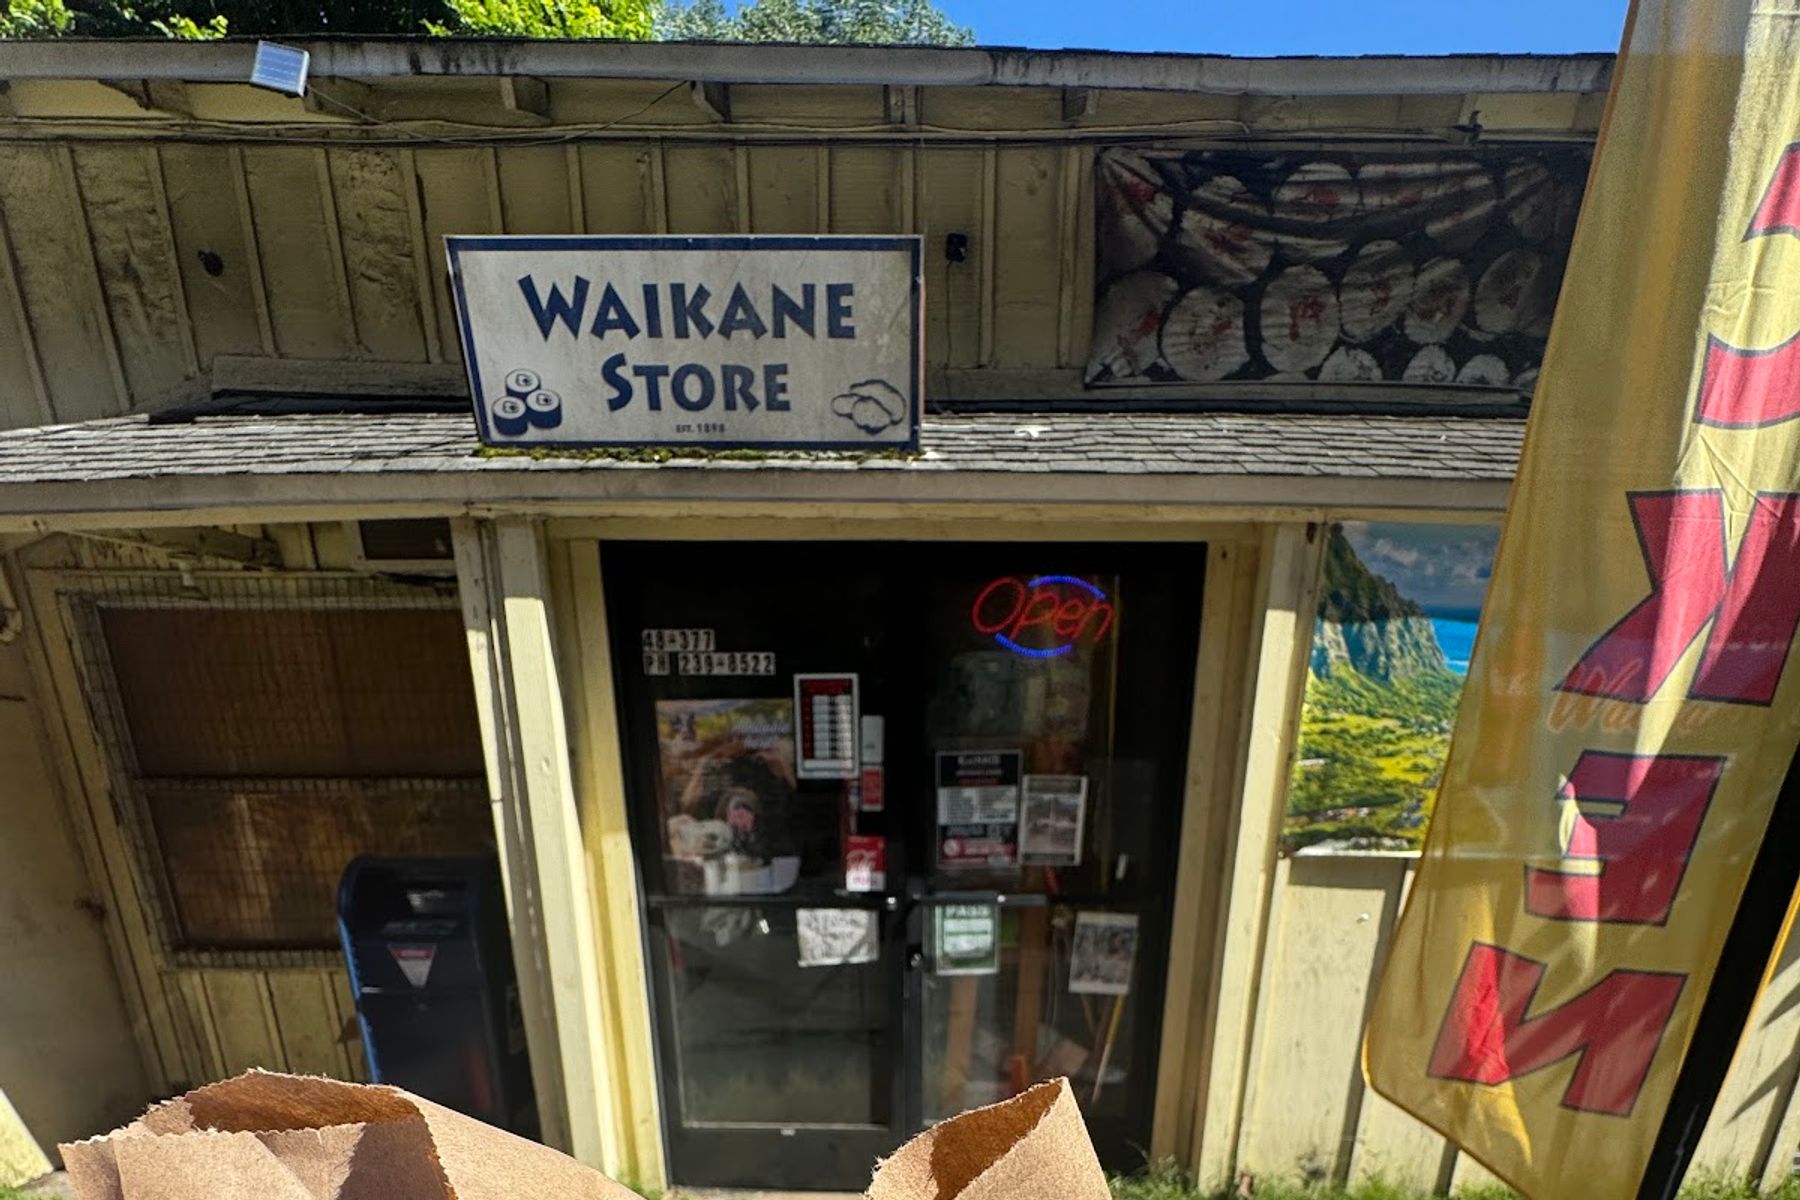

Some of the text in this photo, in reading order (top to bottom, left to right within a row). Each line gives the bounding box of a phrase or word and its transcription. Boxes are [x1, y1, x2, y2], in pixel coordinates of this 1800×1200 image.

[517, 274, 856, 342] WAIKANE
[601, 352, 791, 413] STORE
[972, 576, 1114, 643] Open
